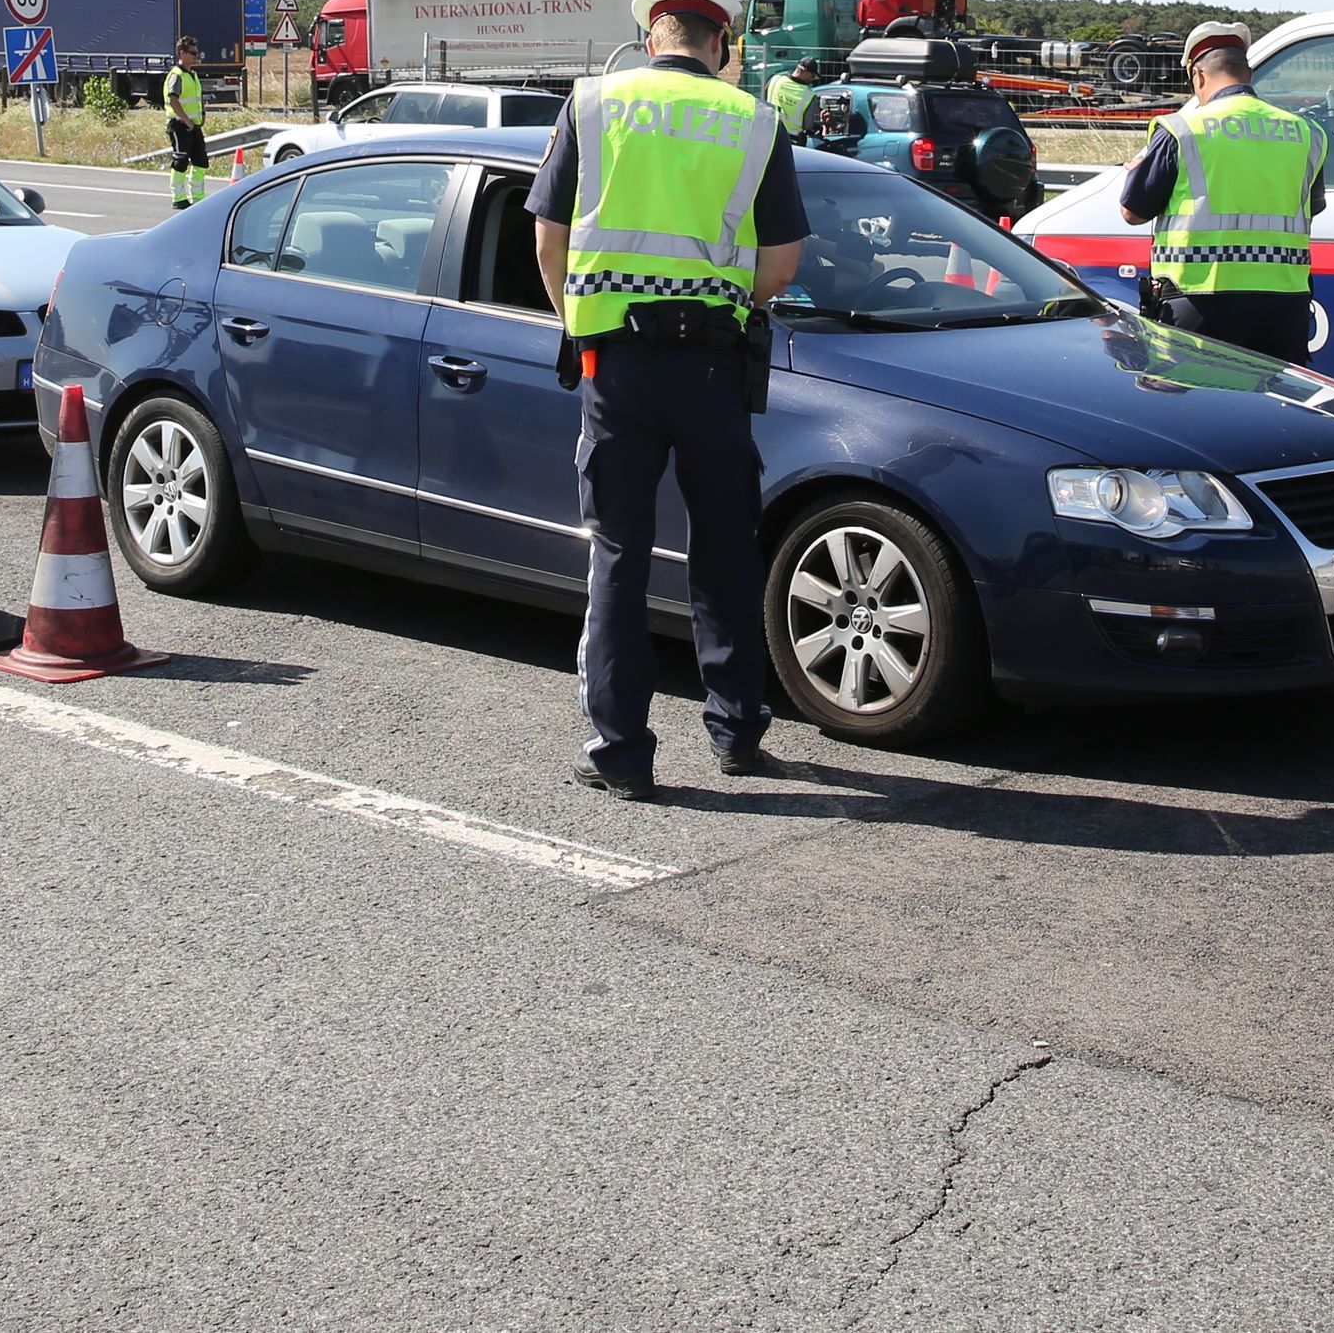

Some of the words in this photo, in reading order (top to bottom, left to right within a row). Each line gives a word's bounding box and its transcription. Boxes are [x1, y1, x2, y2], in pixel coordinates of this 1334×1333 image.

[476, 23, 527, 36] HUNGARY
[601, 97, 753, 151] POLIZEI
[1202, 116, 1304, 144] POLIZEI
[22, 378, 31, 387] H
